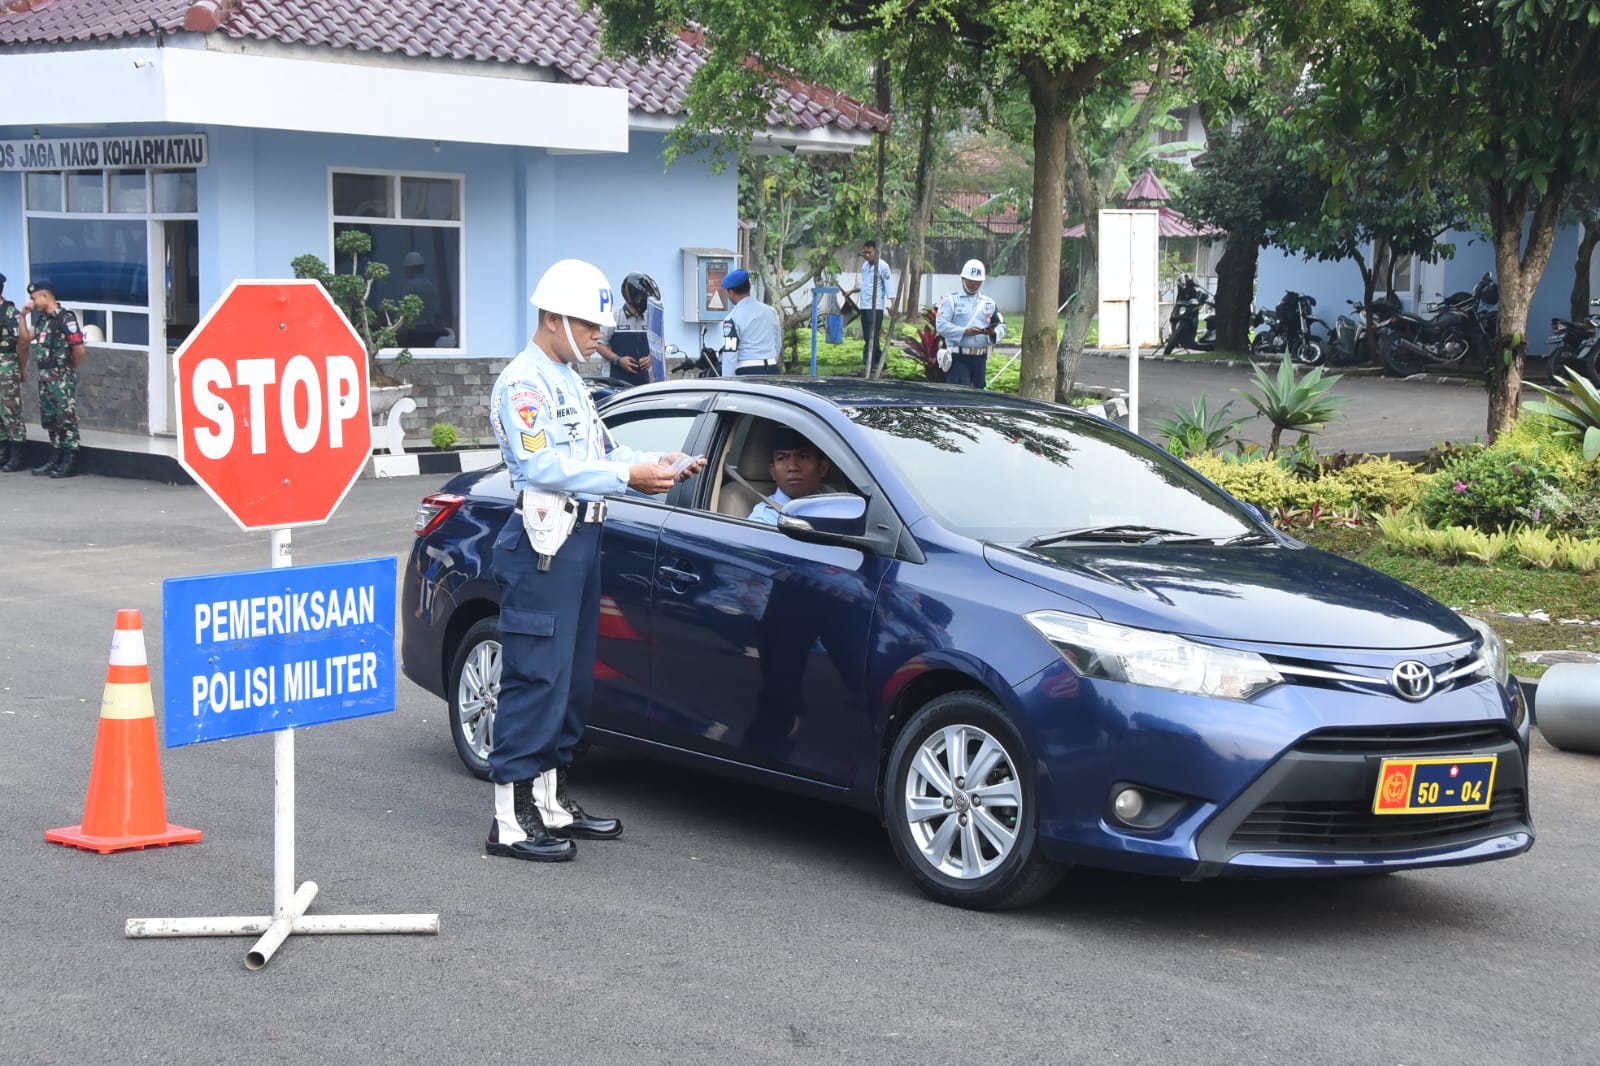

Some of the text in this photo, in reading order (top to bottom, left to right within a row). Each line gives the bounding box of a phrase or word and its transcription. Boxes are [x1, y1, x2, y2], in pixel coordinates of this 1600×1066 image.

[20, 142, 56, 167] JAGA
[60, 141, 99, 167] MAKO
[103, 138, 204, 166] KOHARMATAU
[599, 288, 613, 312] P
[192, 355, 360, 460] STOP
[195, 585, 375, 644] PEMERIKSAAN
[192, 651, 377, 717] POLISI MILITER
[1417, 782, 1439, 804] 50
[1461, 780, 1483, 802] 04
